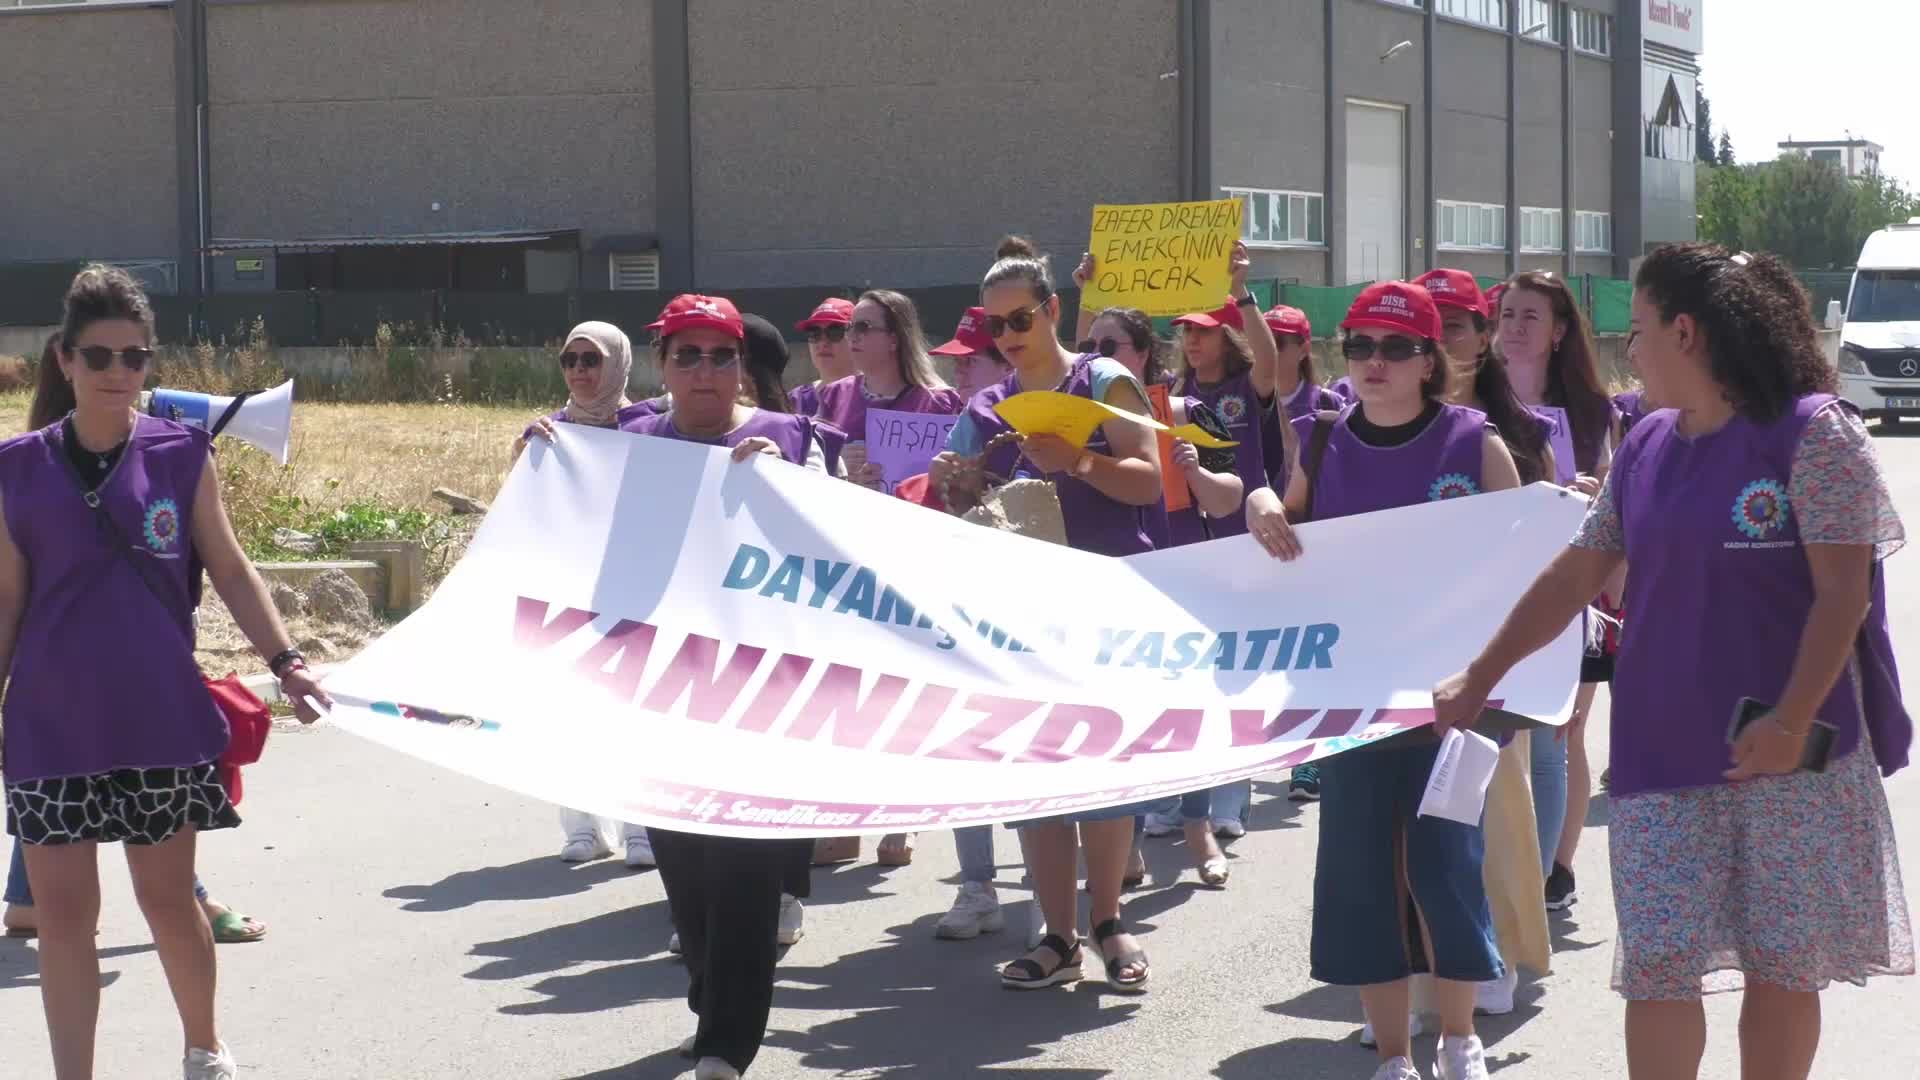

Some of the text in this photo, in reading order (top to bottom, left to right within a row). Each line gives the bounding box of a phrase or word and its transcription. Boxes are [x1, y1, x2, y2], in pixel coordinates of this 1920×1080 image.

[1093, 200, 1243, 234] ZAFER DİRENEN
[1104, 228, 1229, 265] EMEKÇİNİN
[1097, 265, 1203, 293] OLACAK
[1094, 623, 1340, 681] YAŞATIR
